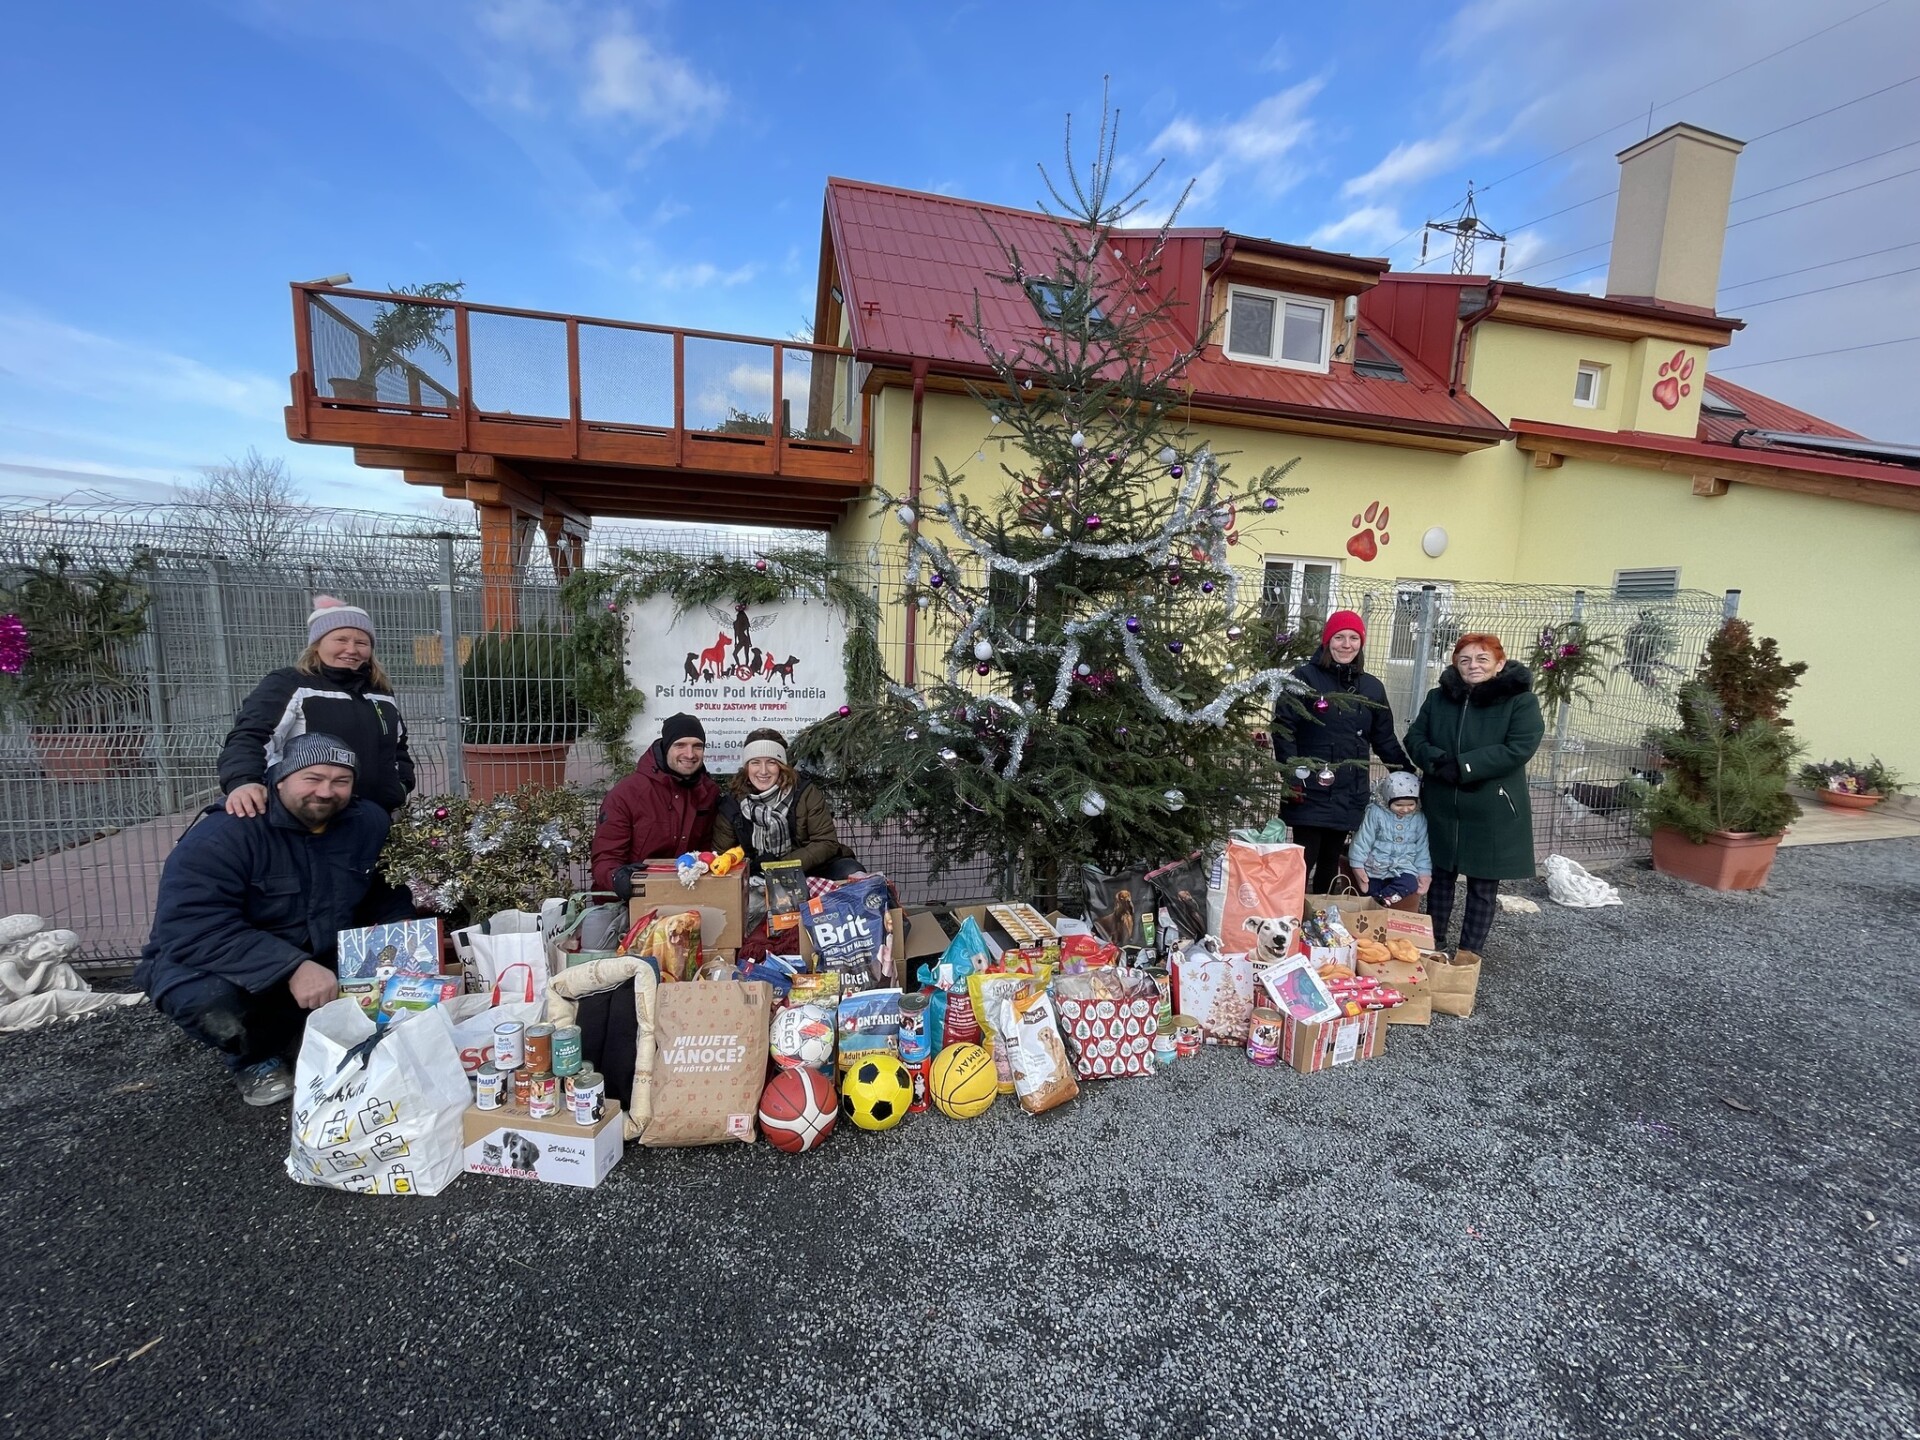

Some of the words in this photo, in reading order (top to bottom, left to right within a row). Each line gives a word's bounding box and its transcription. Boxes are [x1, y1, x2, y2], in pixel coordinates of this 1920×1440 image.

[655, 685, 675, 698] Psí
[680, 686, 718, 698] domov
[723, 686, 746, 698] Pod
[750, 686, 784, 700] křídly
[787, 687, 826, 699] anděla
[695, 703, 721, 711] SPOLKU
[722, 703, 757, 711] ZASTAVME
[704, 741, 721, 749] el.:
[814, 914, 871, 947] Brit
[784, 1012, 796, 1049] SELECT
[673, 1035, 738, 1047] MILUJETE
[663, 1045, 746, 1064] VÁNOCE?
[844, 1051, 860, 1060] Adult
[711, 1064, 732, 1072] NÁM.
[470, 1162, 539, 1179] www.akinu.cz
